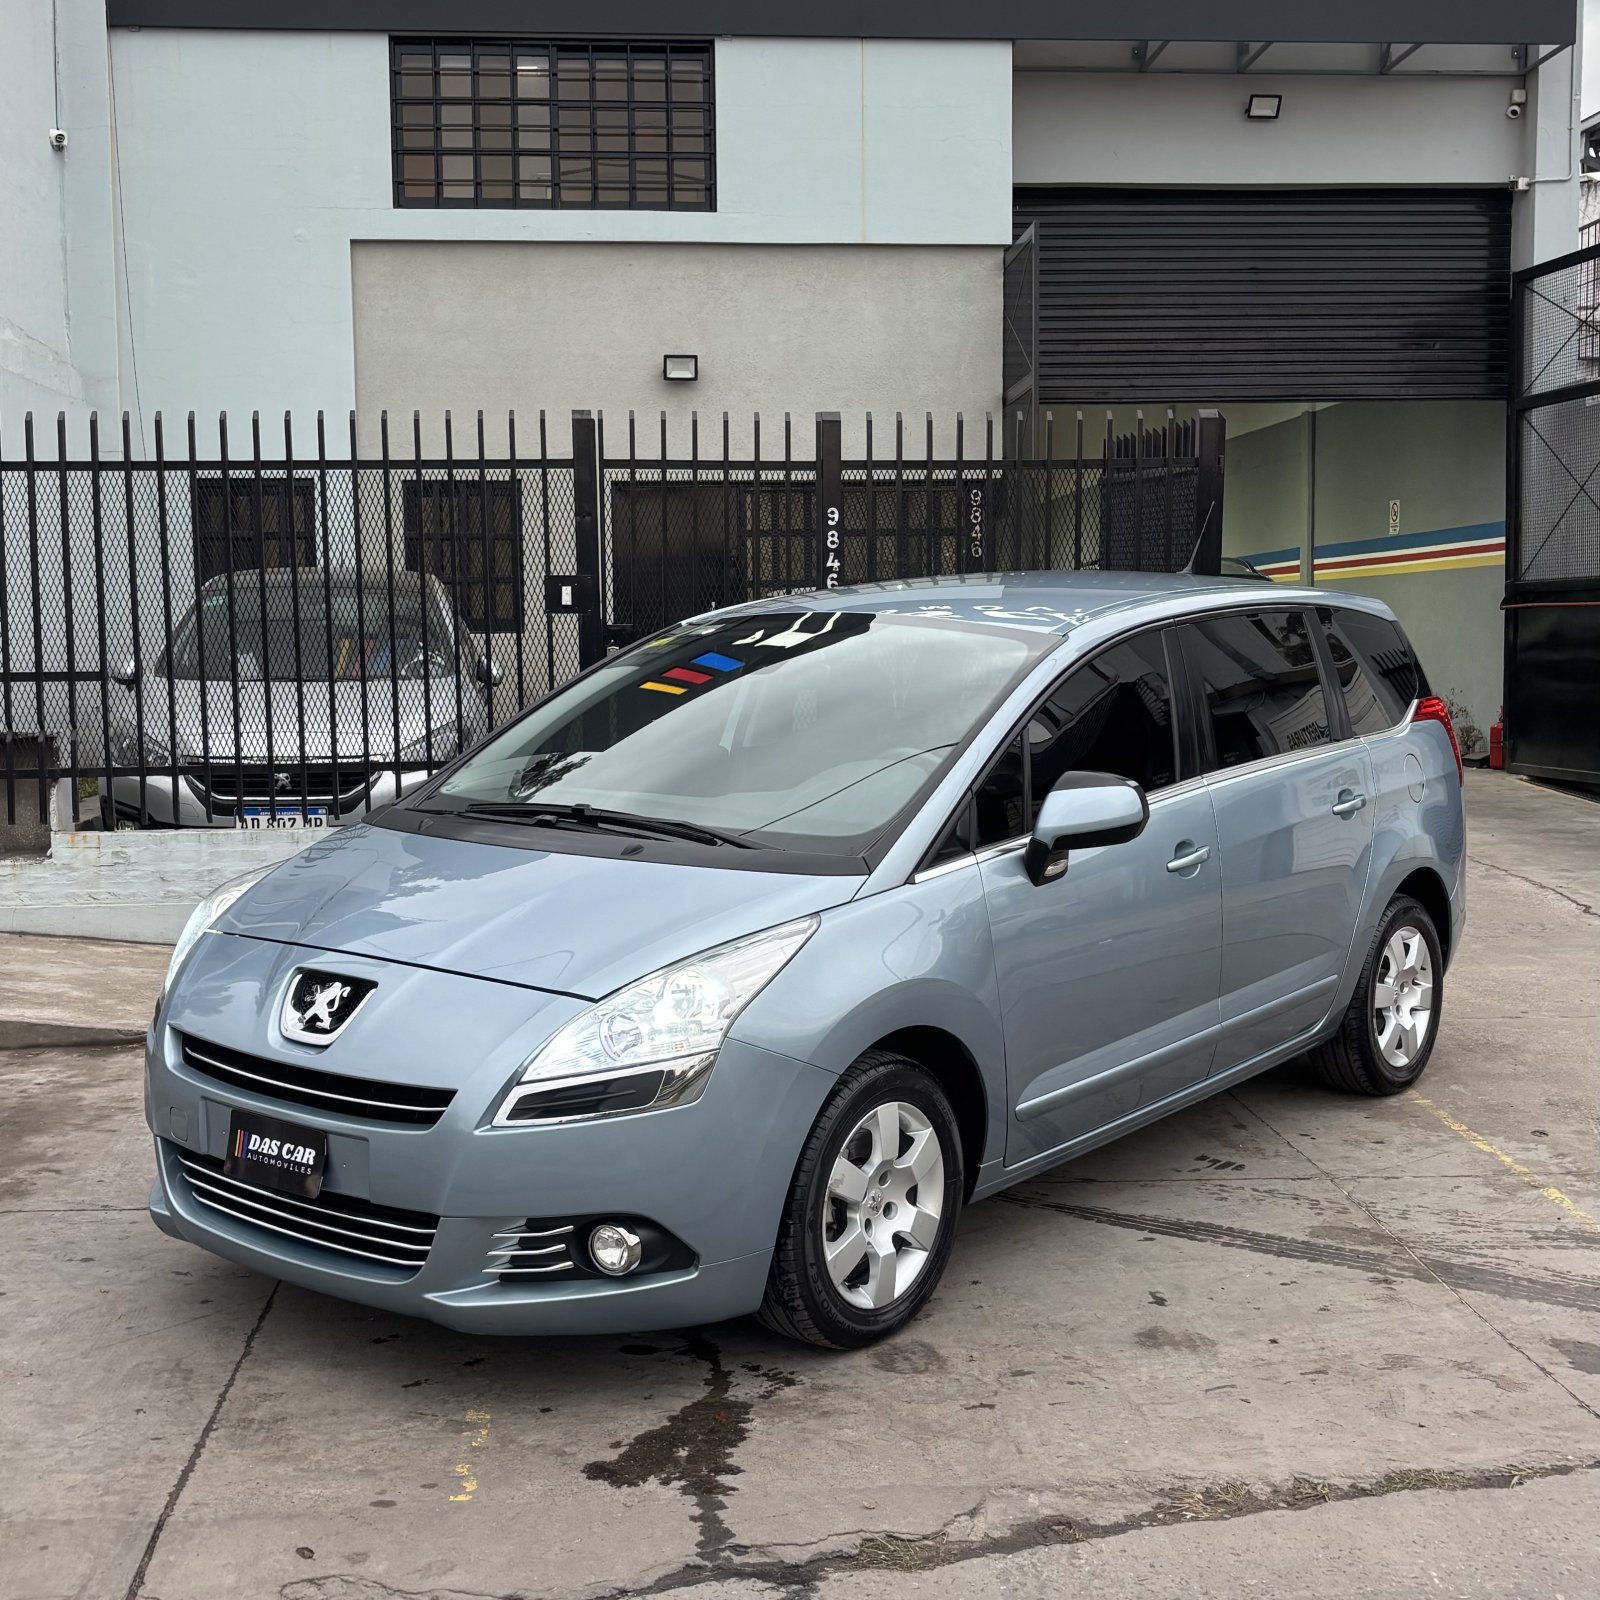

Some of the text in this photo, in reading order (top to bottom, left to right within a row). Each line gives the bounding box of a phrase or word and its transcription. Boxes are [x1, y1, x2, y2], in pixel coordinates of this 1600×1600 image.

[826, 507, 841, 589] 9846
[246, 1152, 312, 1175] AUTOMOVILES
[248, 1134, 316, 1166] DAS CAR
